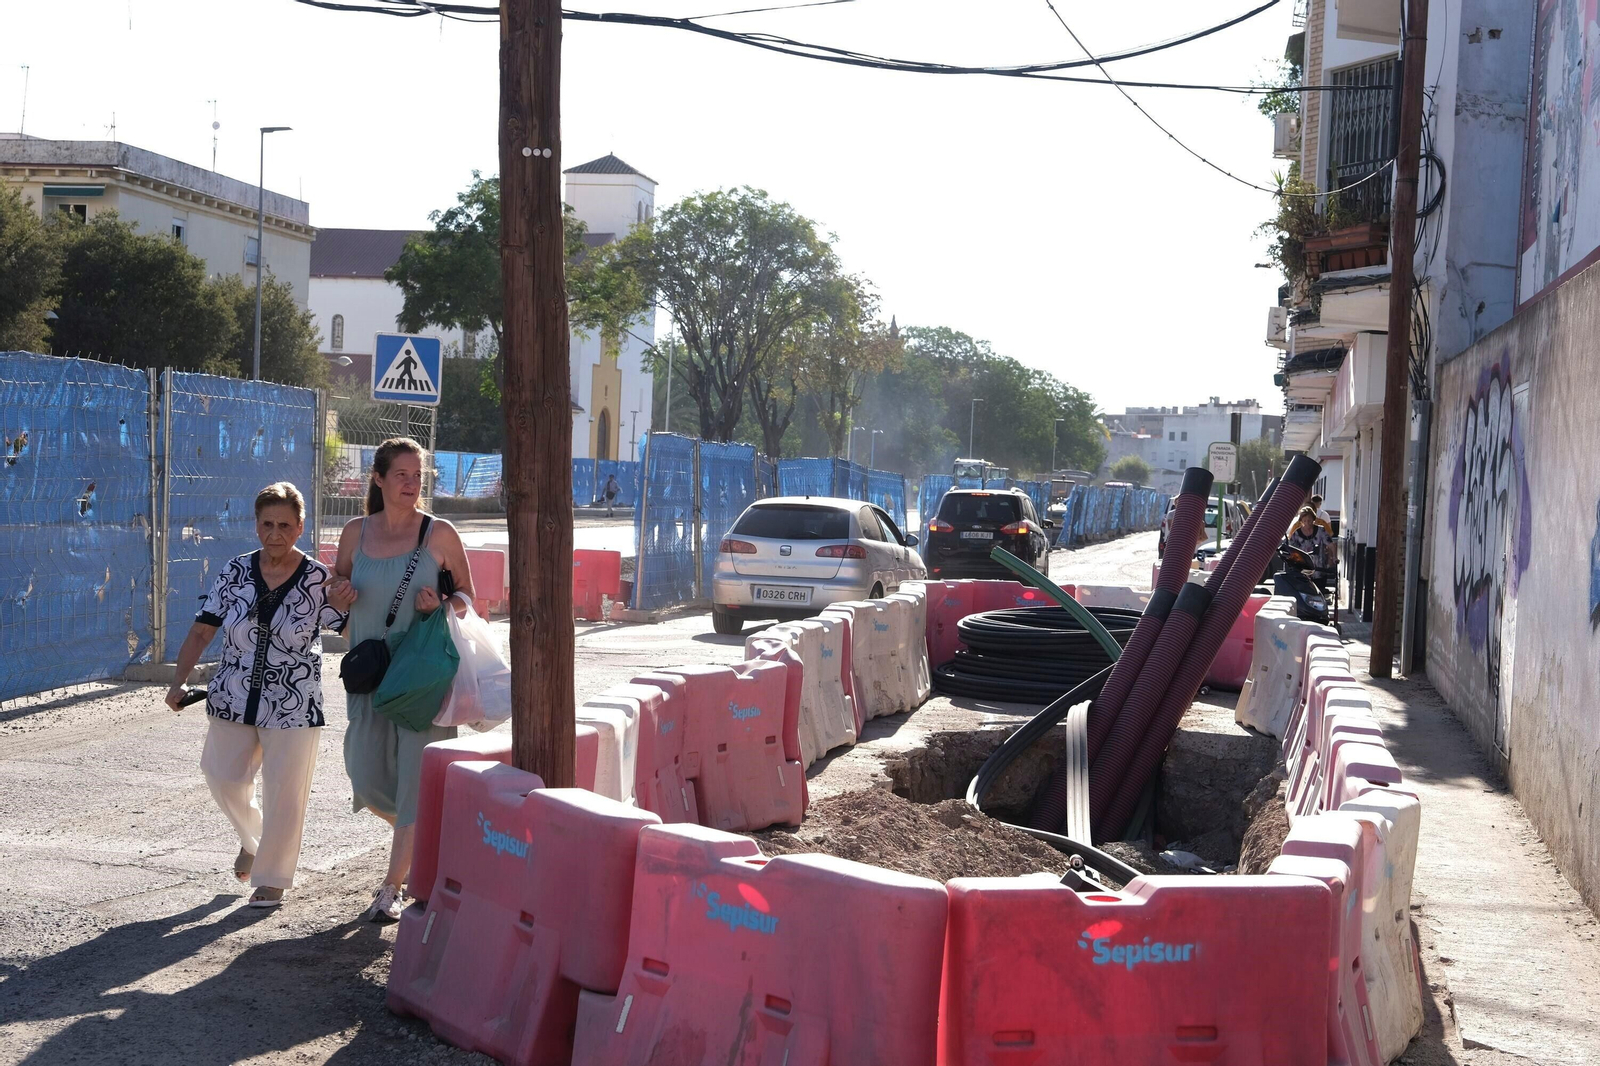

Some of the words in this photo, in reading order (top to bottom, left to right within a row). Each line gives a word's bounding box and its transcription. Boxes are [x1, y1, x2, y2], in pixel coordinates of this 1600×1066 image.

[762, 589, 785, 600] 0326
[788, 591, 806, 601] CRH
[482, 820, 529, 858] Sepisur
[706, 891, 779, 935] Sepisur
[1092, 937, 1194, 971] Sepisur
